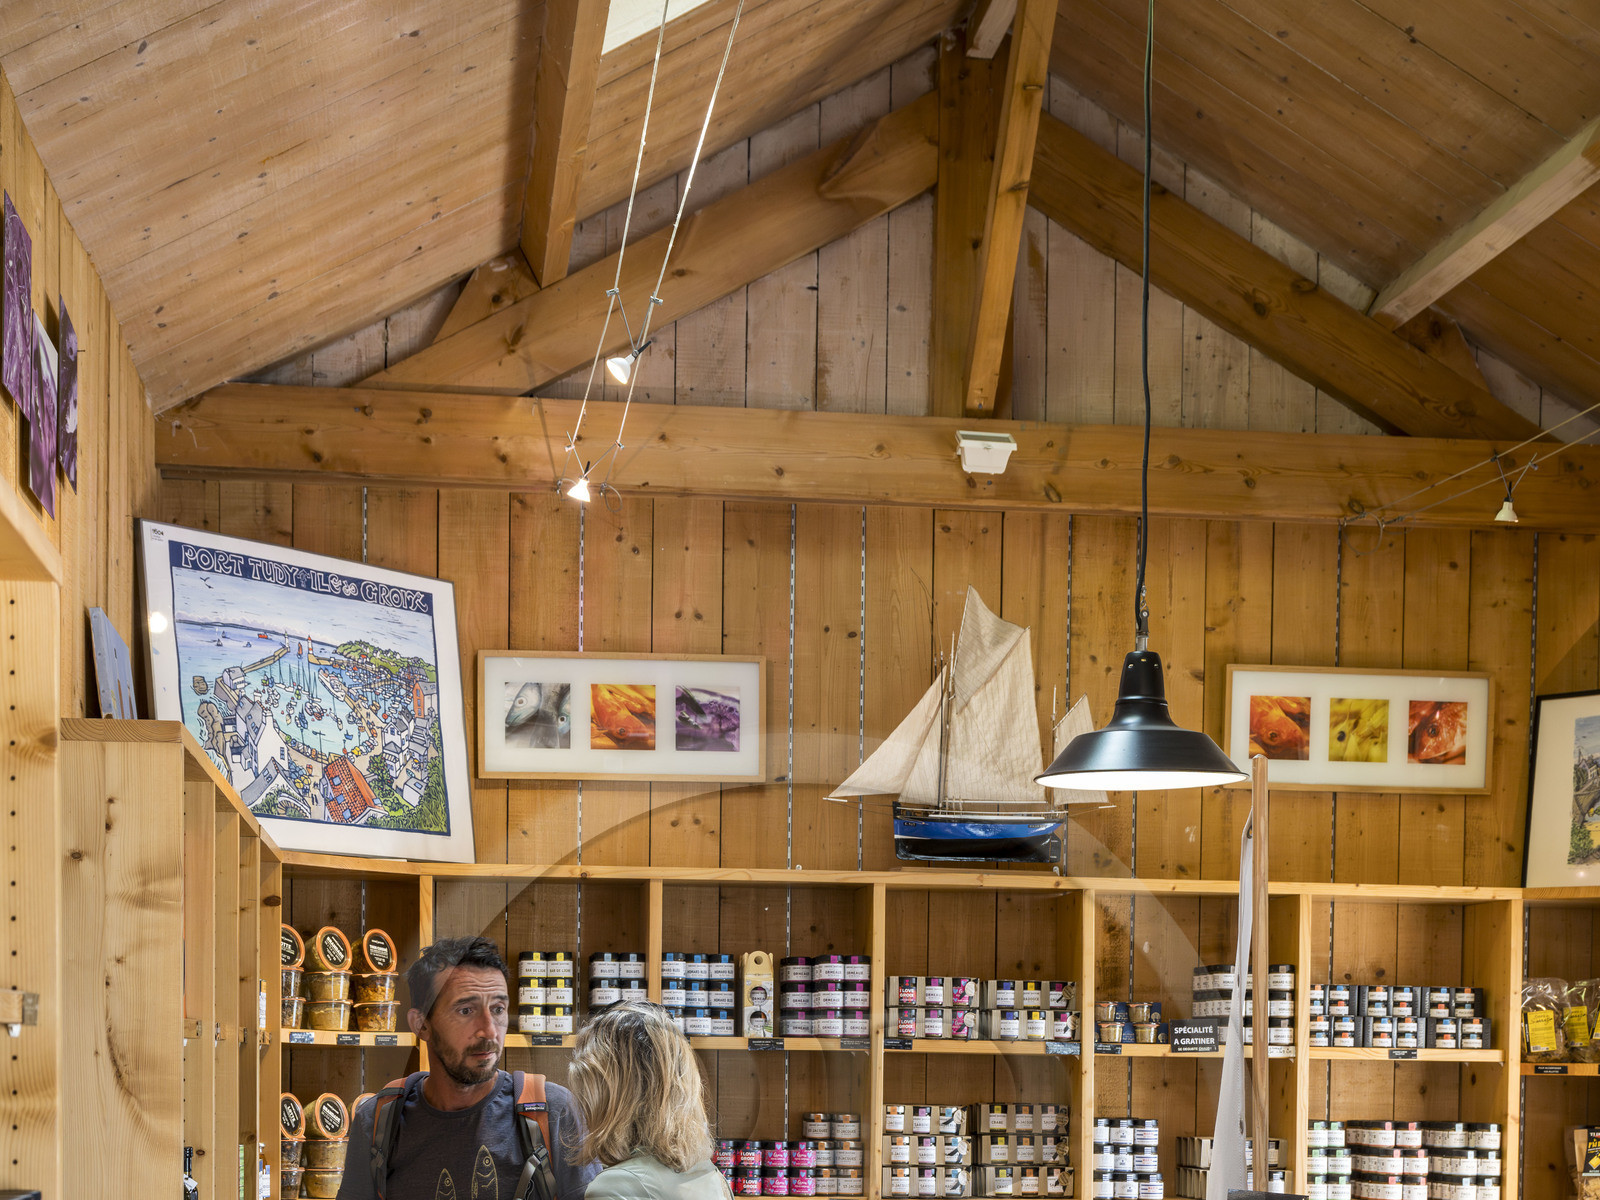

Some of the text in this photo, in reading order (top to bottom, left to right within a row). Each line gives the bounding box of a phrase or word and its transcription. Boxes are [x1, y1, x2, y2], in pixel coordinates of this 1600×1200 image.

[181, 544, 245, 577] PORT
[248, 557, 300, 588] TUDY
[359, 580, 429, 613] GROIX
[1174, 1025, 1214, 1034] SPÉCIALITÉ
[1174, 1037, 1215, 1045] A GRATINER
